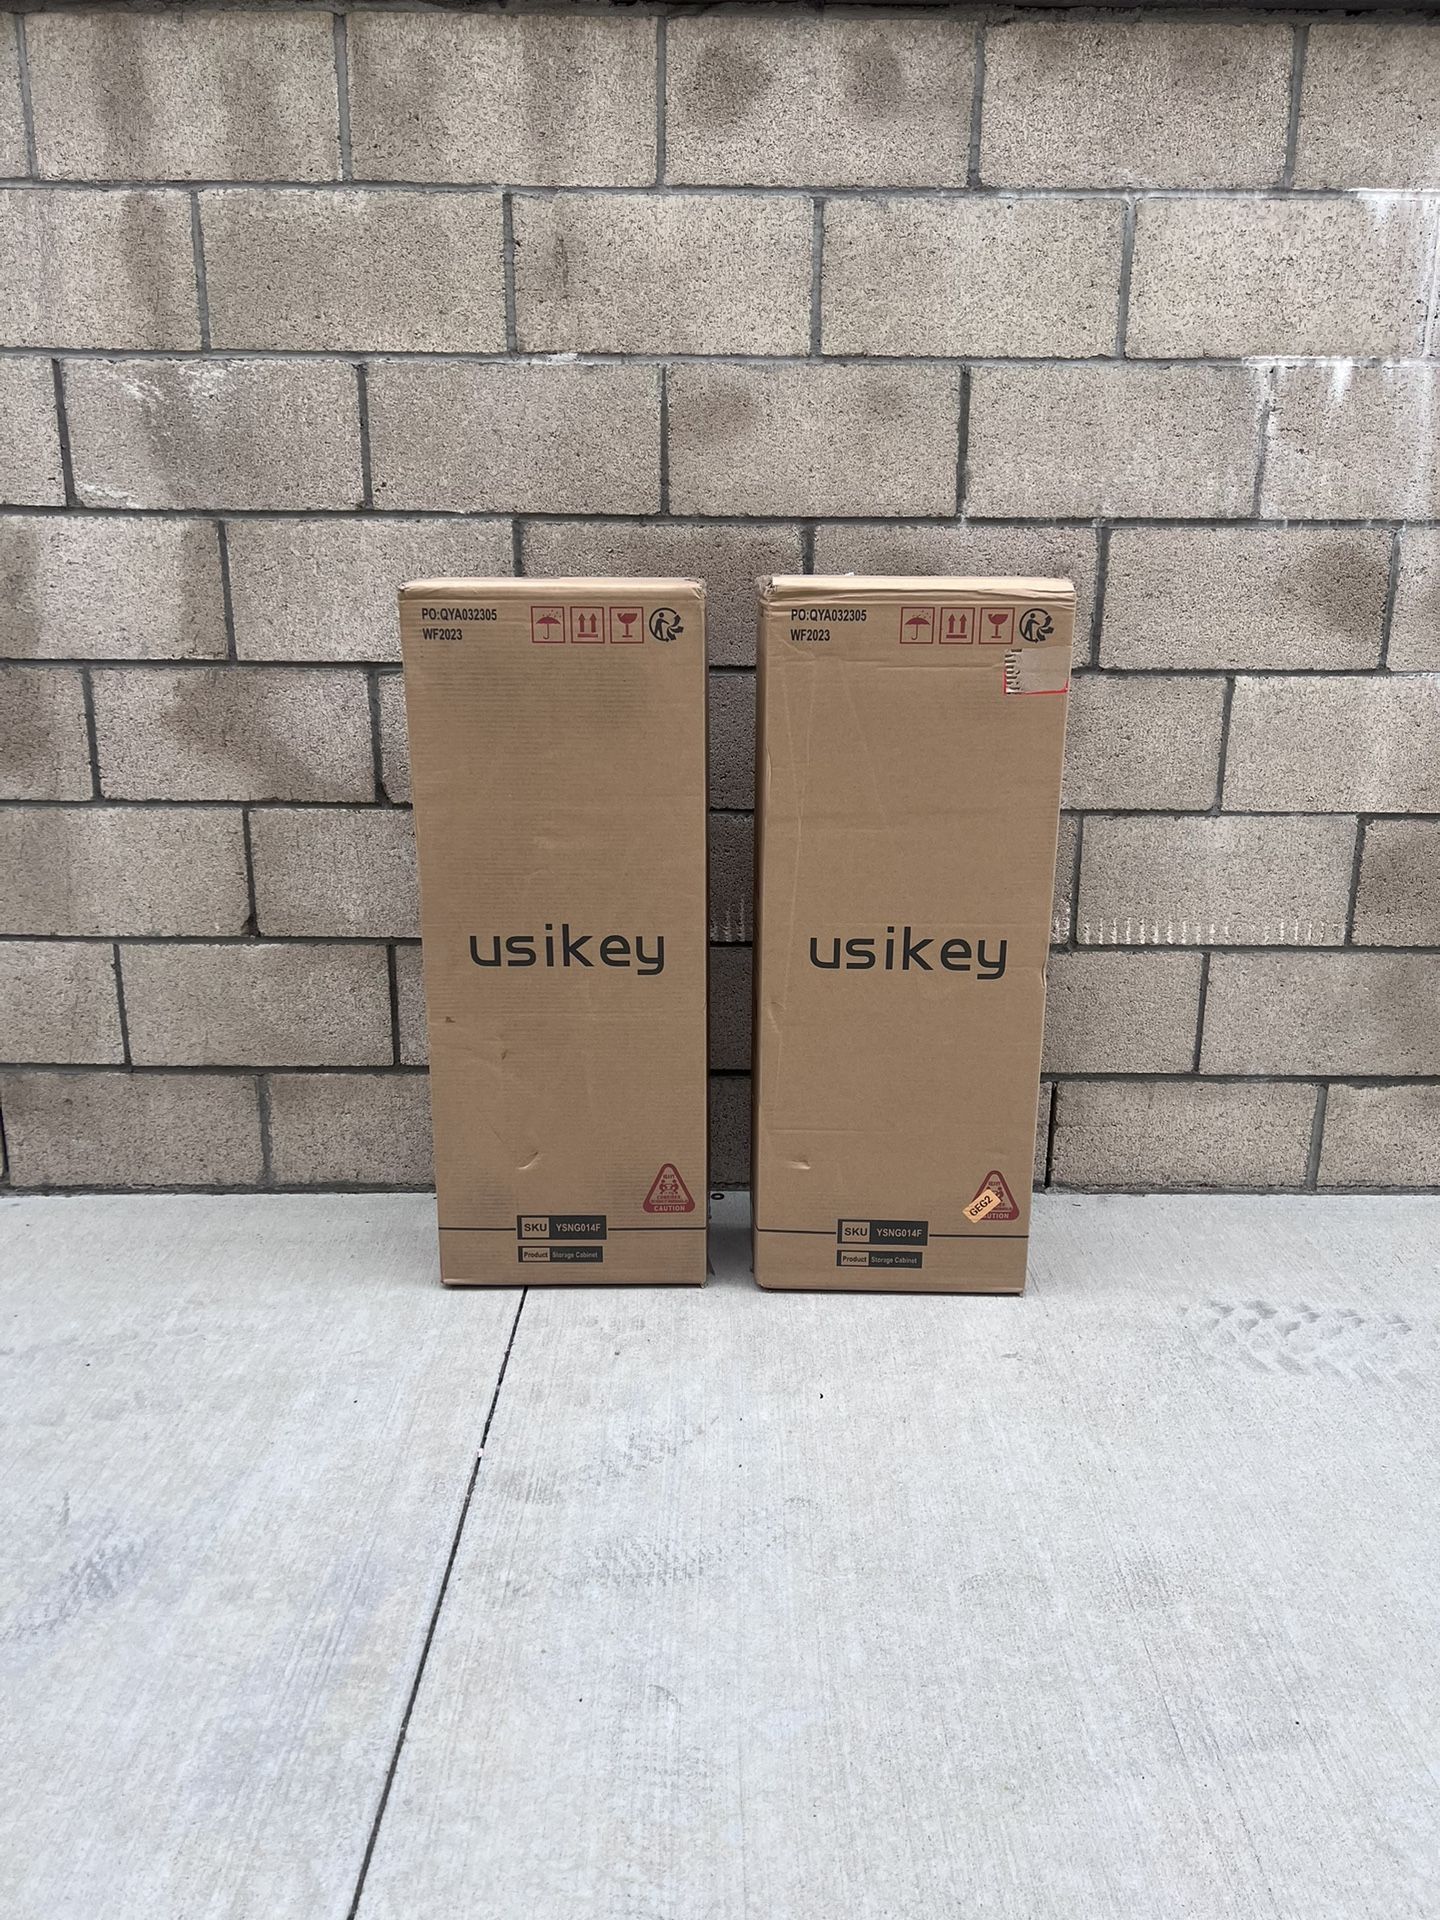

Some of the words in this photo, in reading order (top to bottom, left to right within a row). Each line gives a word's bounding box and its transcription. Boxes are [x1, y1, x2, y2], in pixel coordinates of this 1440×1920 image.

[421, 607, 497, 621] PO:QYA032305
[791, 608, 867, 621] PO:QYA032305
[422, 628, 463, 640] WF2023
[790, 629, 831, 641] WF2023
[469, 923, 664, 976] usikey
[810, 926, 1008, 980] usikey
[969, 1195, 994, 1216] GEG2
[524, 1223, 547, 1232] SKU
[555, 1223, 601, 1232] YSNG014F
[844, 1227, 868, 1237] SKU
[876, 1228, 923, 1238] YSNG014F
[552, 1251, 574, 1259] Storage
[842, 1255, 867, 1263] Product
[871, 1256, 894, 1265] Storage
[894, 1256, 917, 1265] Cabinet
